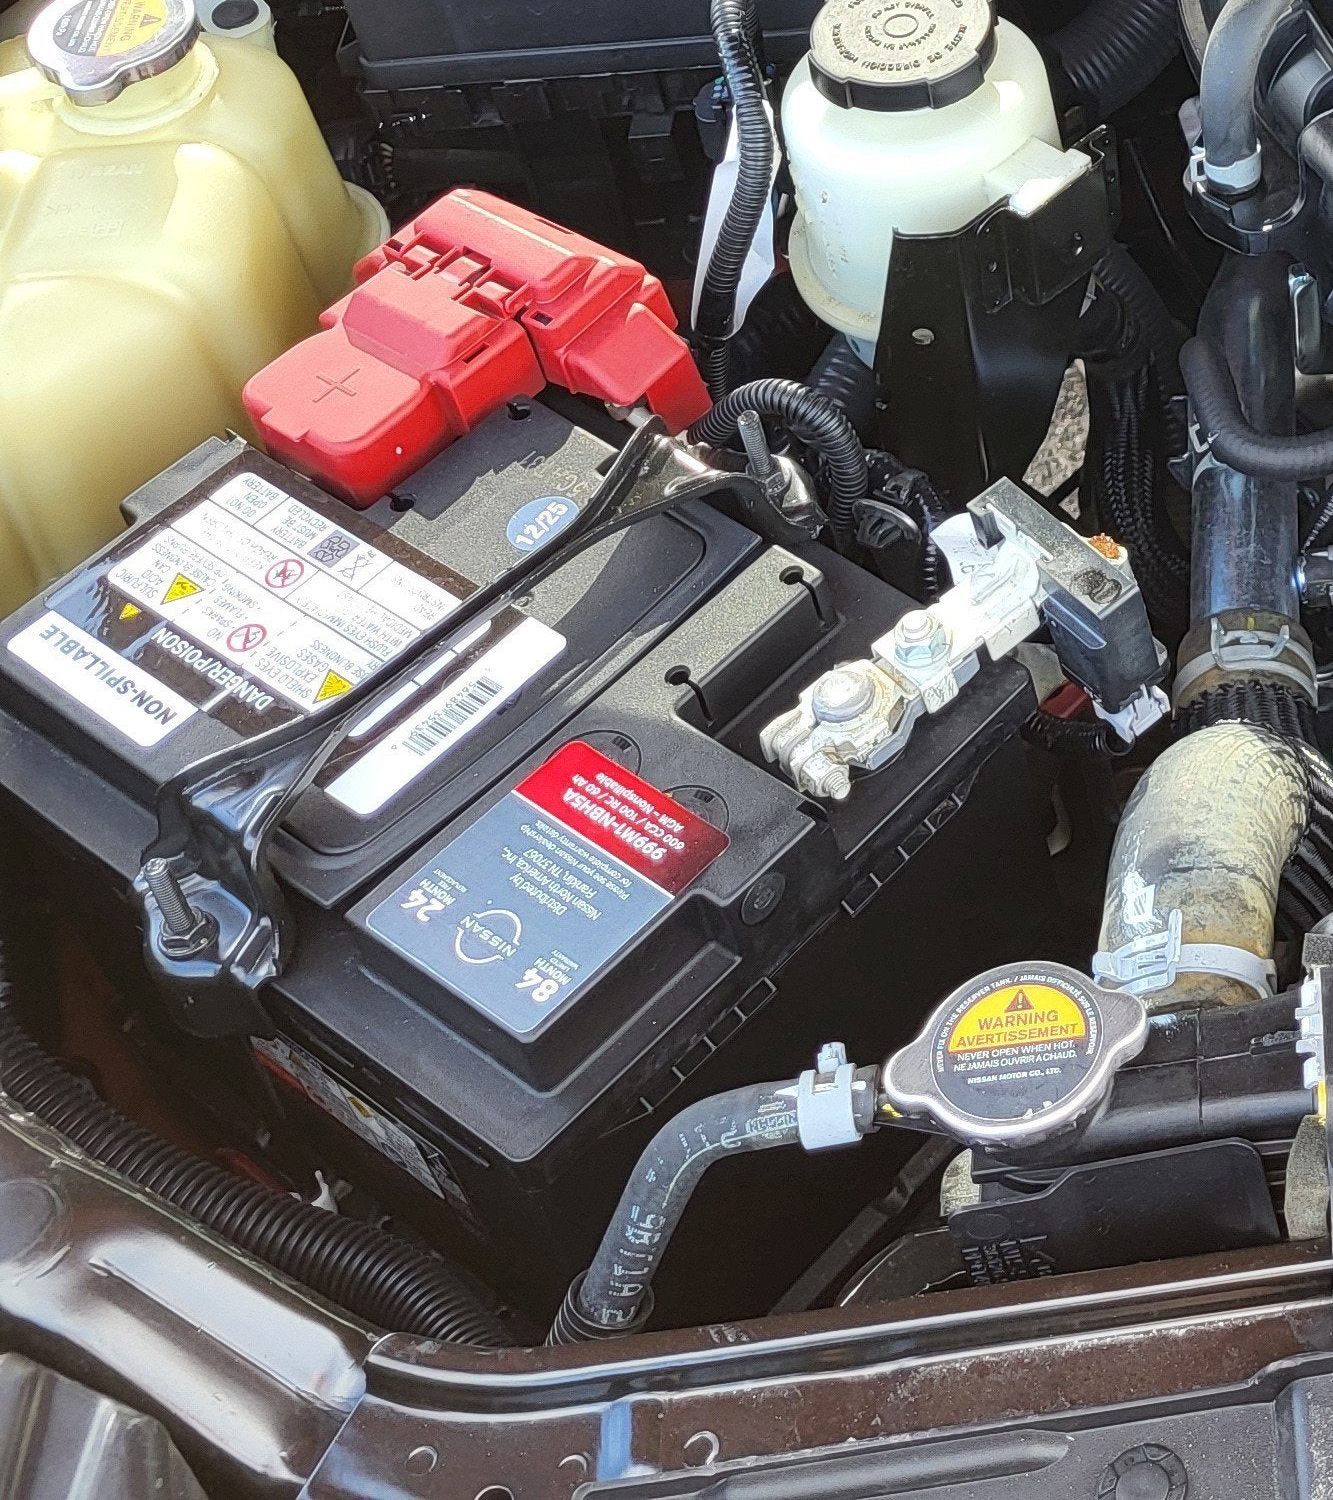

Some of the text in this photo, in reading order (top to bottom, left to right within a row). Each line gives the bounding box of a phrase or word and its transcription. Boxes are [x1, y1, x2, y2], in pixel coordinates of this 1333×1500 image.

[224, 495, 258, 517] DO NOT
[241, 491, 270, 509] OPEN
[269, 523, 308, 549] BATTERY
[279, 515, 319, 541] MUST BE
[513, 499, 571, 550] 12/25
[139, 568, 166, 587] ACID
[150, 558, 172, 573] CAN
[188, 566, 217, 587] CAUSE
[113, 567, 160, 599] SULFURIC
[219, 582, 259, 609] SMOKING
[200, 605, 234, 628] SPARKS
[211, 594, 247, 618] FLAMES
[204, 626, 226, 641] NO
[340, 624, 370, 641] EYES
[263, 645, 319, 684] EXPLOSIVE
[293, 647, 331, 673] GASES
[307, 638, 356, 670] BLINDNESS
[36, 623, 179, 725] NON-SPILLABLE
[148, 624, 275, 712] DANGER/POISON
[252, 656, 314, 699] SHIELD EYES
[568, 772, 590, 788] Ah
[582, 781, 603, 797] 60
[590, 769, 658, 815] Nonspillable
[602, 794, 623, 810] RC
[616, 803, 641, 821] 100
[557, 786, 670, 862] 999M1-NBH5A
[640, 819, 667, 839] CCA
[655, 812, 686, 834] AGM
[555, 833, 592, 860] warranty
[660, 832, 687, 851] 600
[511, 855, 554, 887] America,
[517, 822, 631, 900] Please see your Nissan dealership
[521, 846, 599, 900] Franklin, TN 37067
[585, 853, 624, 880] complete
[417, 876, 457, 906] MONTH
[506, 870, 569, 917] Distributed by
[544, 879, 576, 903] North
[616, 875, 633, 888] for
[396, 885, 446, 924] 24
[567, 895, 603, 921] Nissan
[458, 914, 518, 958] NISSAN
[531, 955, 572, 986] MONTH
[511, 964, 562, 1005] 84
[945, 1012, 959, 1025] THE
[977, 1009, 1058, 1030] WARNING
[955, 1022, 1078, 1047] AVERTISSEMENT
[953, 1064, 966, 1072] NE
[966, 1059, 999, 1071] JAMAIS
[1000, 1055, 1034, 1066] OUVRIR
[1042, 1049, 1077, 1060] CHAUD.
[957, 1039, 1076, 1061] NEVER OPEN WHEN HOT.
[967, 1075, 997, 1084] NISSAN
[999, 1072, 1027, 1080] MOTOR
